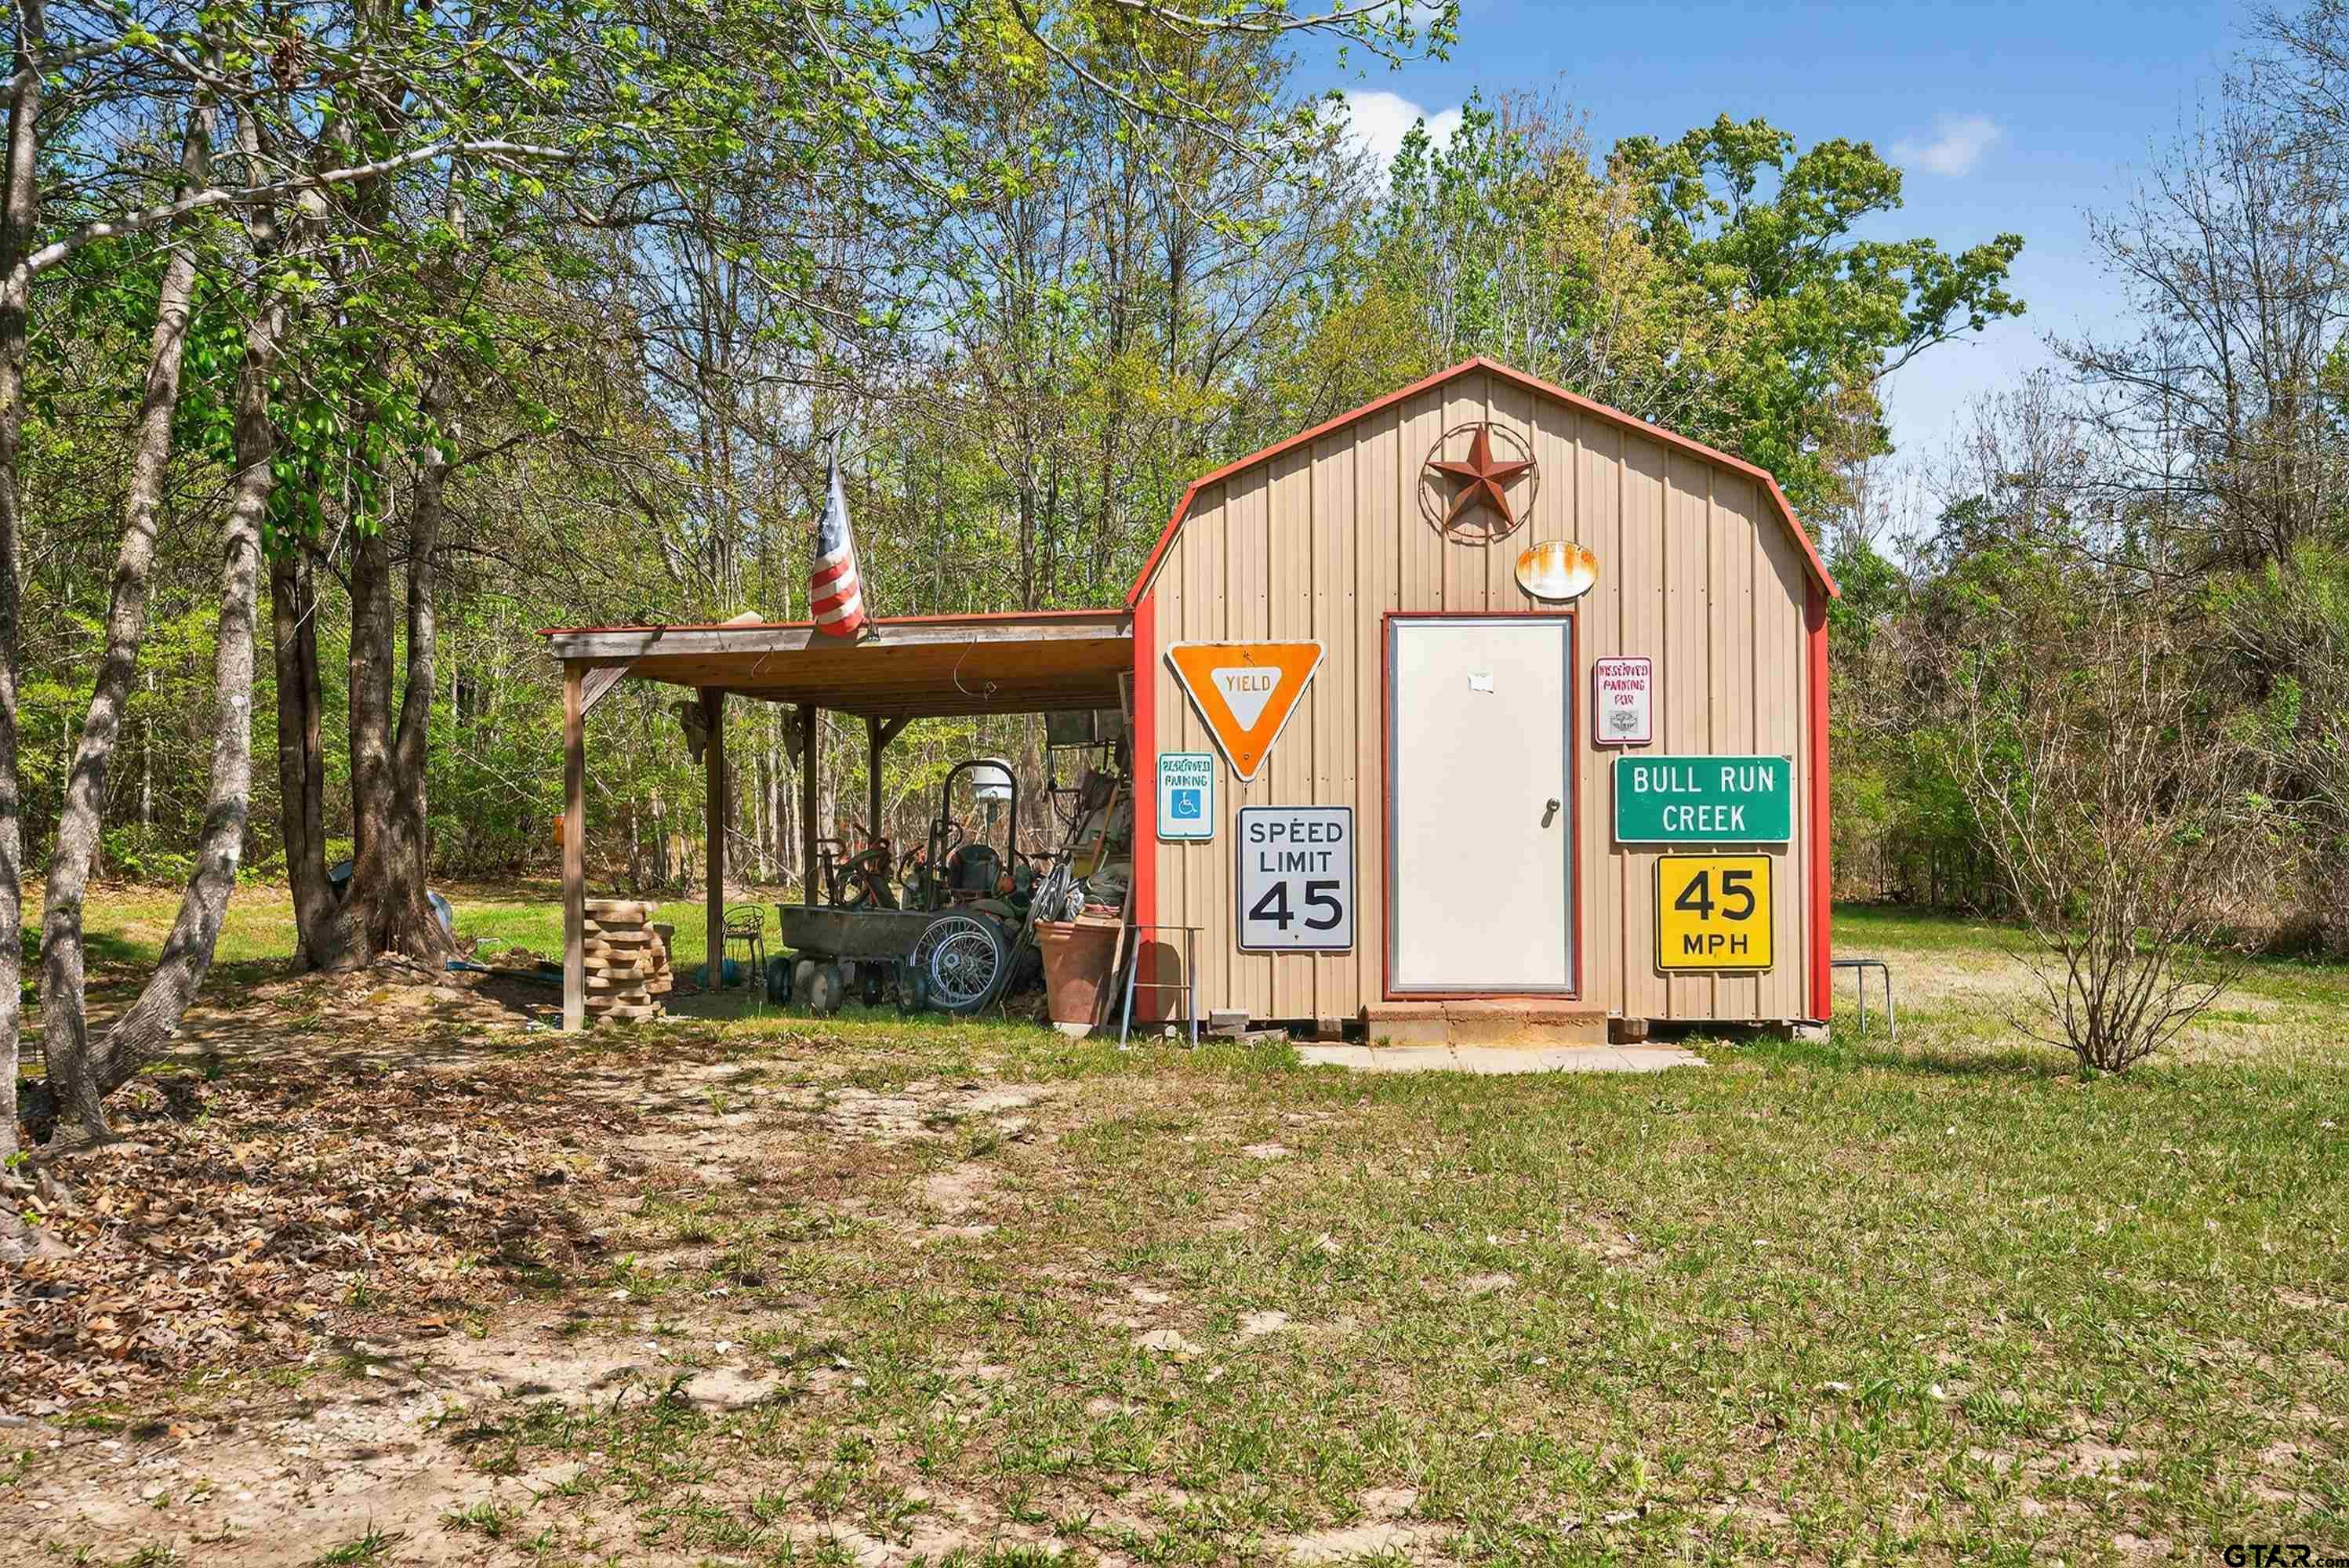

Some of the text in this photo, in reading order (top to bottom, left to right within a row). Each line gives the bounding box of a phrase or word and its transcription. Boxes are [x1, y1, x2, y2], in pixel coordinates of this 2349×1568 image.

[1225, 675, 1271, 692] YIELD
[1633, 766, 1774, 793] BULL RUN
[1663, 805, 1746, 831] CREEK
[1250, 822, 1342, 844] SPEED
[1260, 851, 1332, 873] LIMIT
[1248, 880, 1343, 931] 45
[1675, 869, 1755, 921] 45
[1683, 934, 1748, 955] MPH
